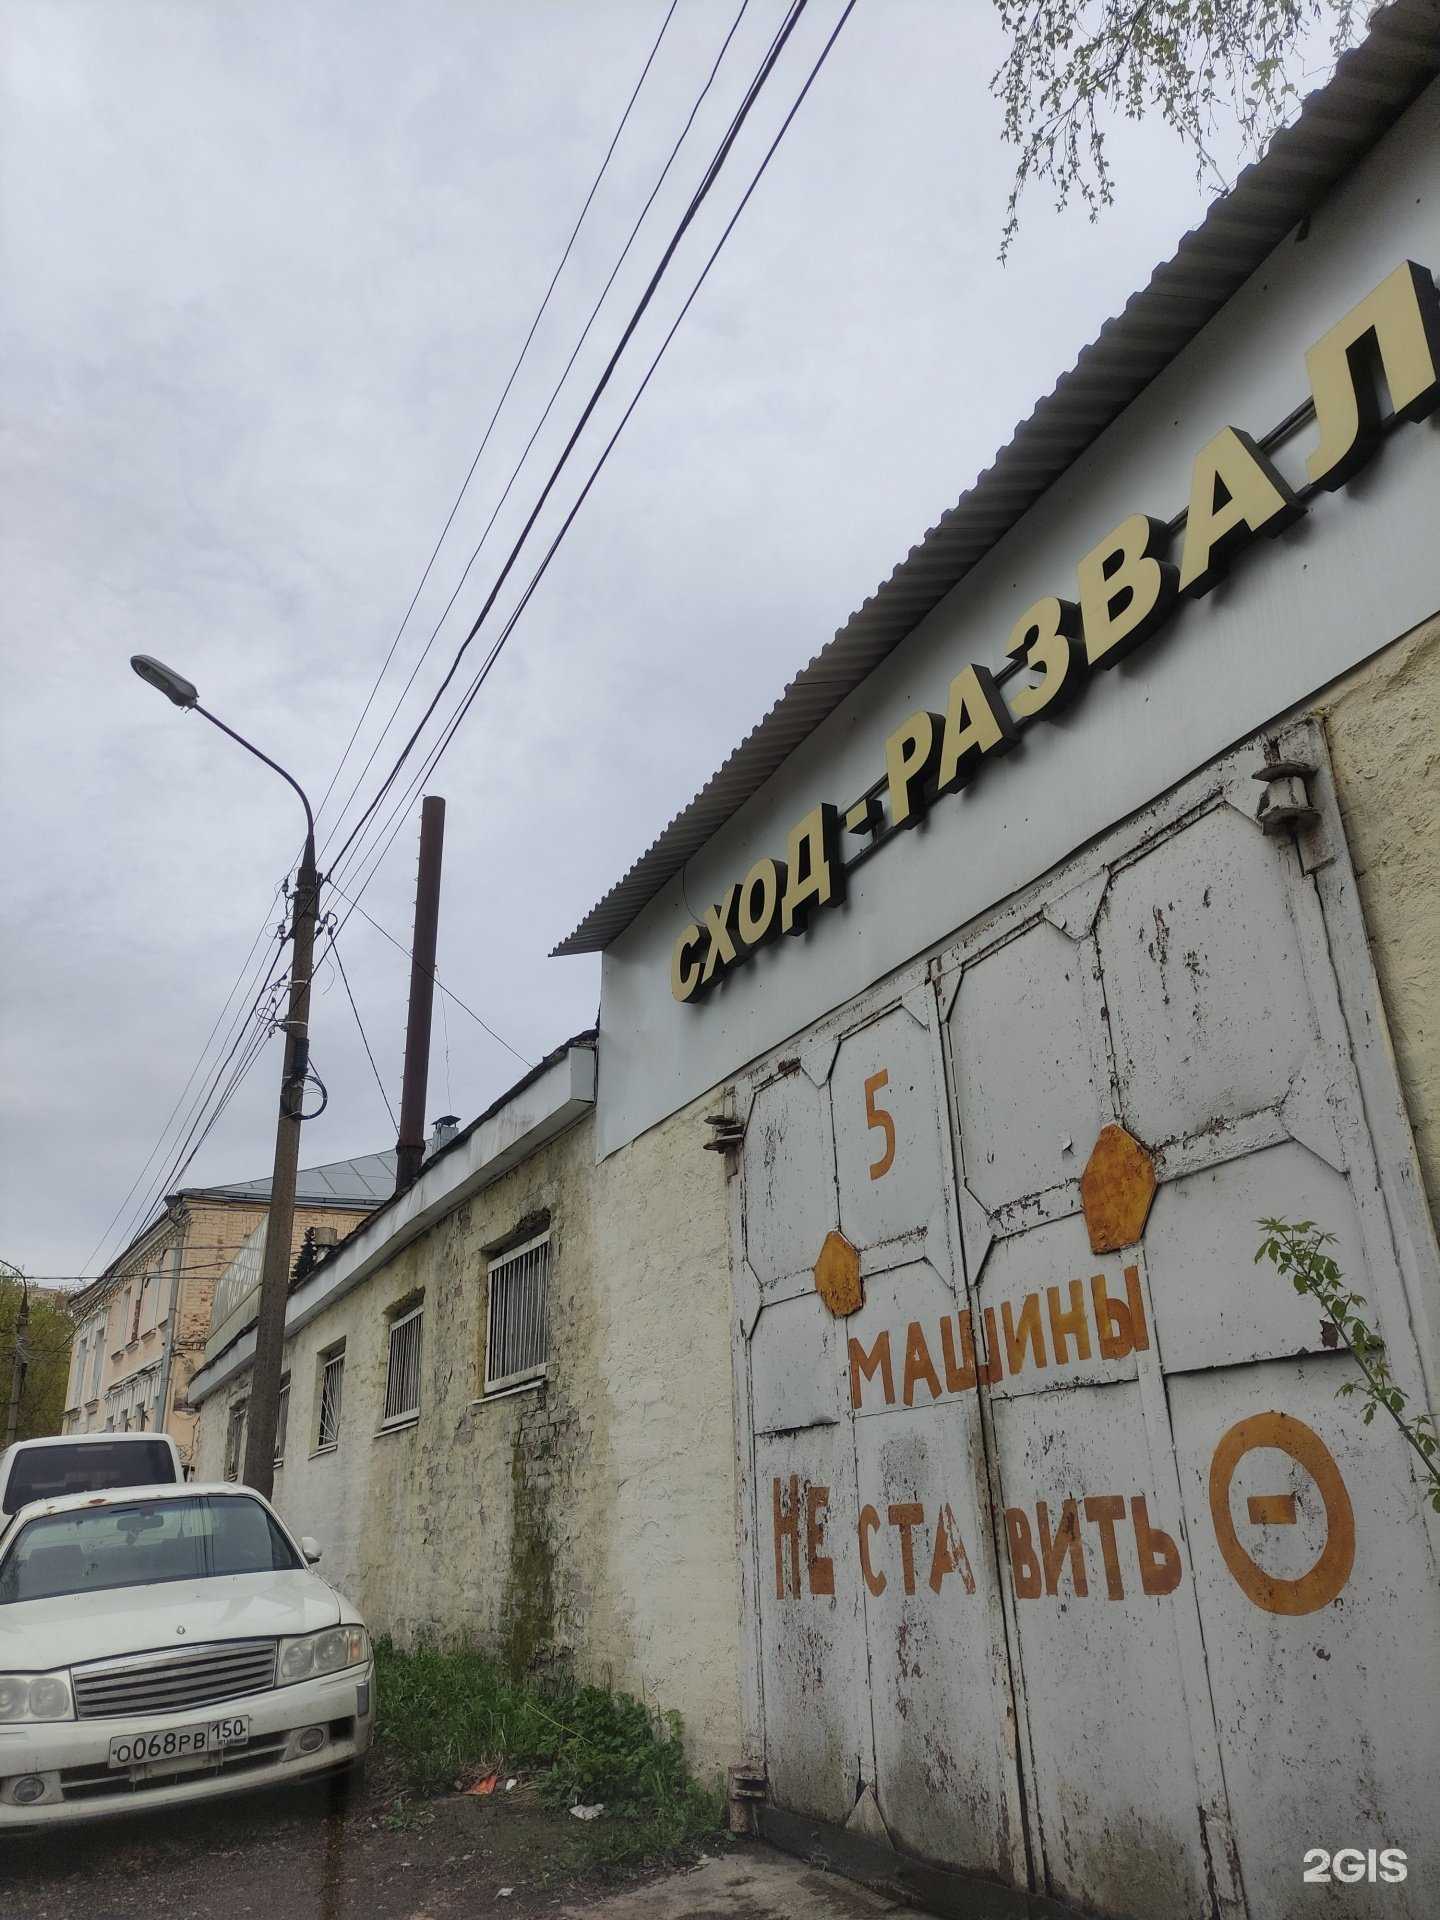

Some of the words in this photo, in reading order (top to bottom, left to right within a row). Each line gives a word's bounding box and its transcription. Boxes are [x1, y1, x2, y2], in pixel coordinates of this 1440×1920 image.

[670, 259, 1440, 1005] СХОД-РАЗВАЛ
[864, 1067, 896, 1181] 5
[847, 1265, 1150, 1409] МАШИНЫ
[772, 1473, 836, 1601] НЕ
[212, 1719, 243, 1739] 150
